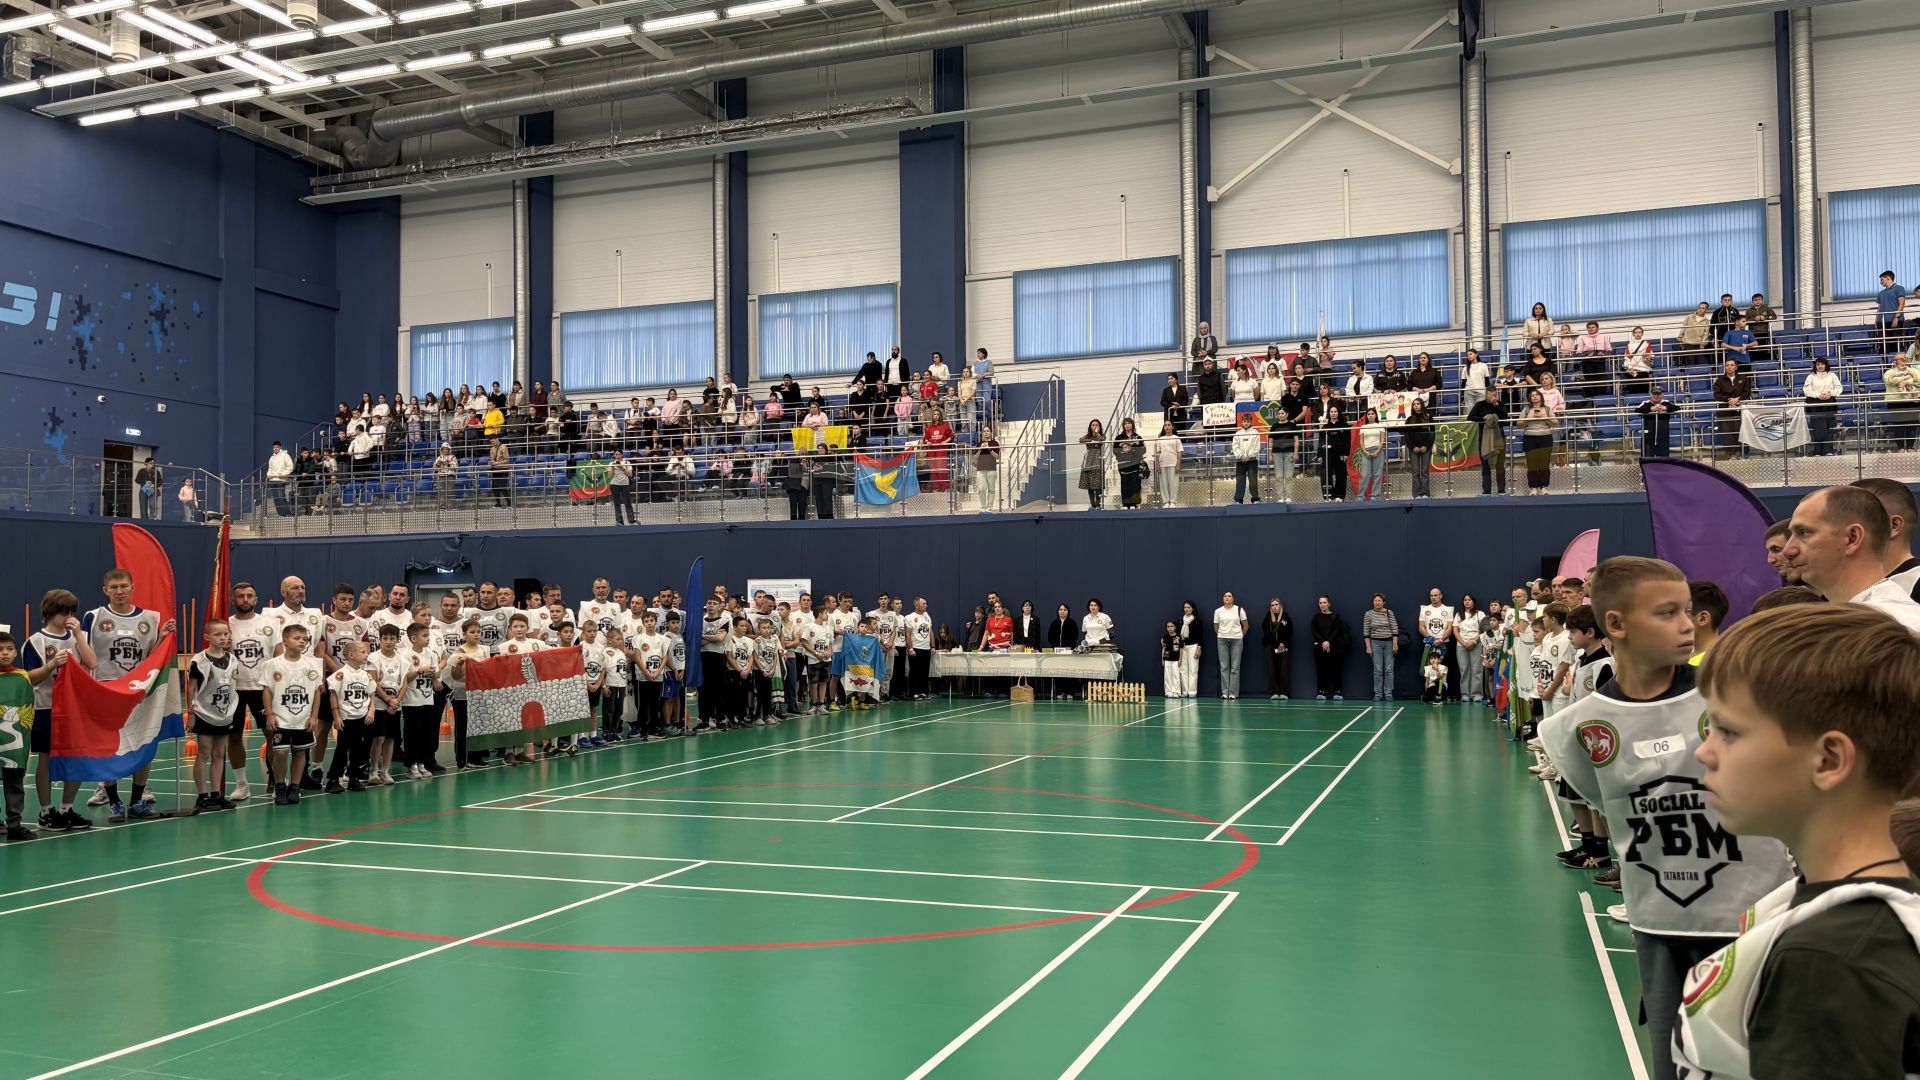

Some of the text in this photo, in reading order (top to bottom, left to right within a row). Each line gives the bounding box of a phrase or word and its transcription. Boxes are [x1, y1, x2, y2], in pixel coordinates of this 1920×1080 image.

[109, 647, 143, 662] РБМ
[233, 647, 264, 660] РБМ
[281, 693, 310, 706] РБМ
[344, 690, 369, 701] РБМ
[1653, 740, 1670, 753] 06
[1639, 793, 1706, 814] SOCIAL
[1625, 812, 1743, 862] РБМ
[1663, 871, 1699, 881] TATARSTAN
